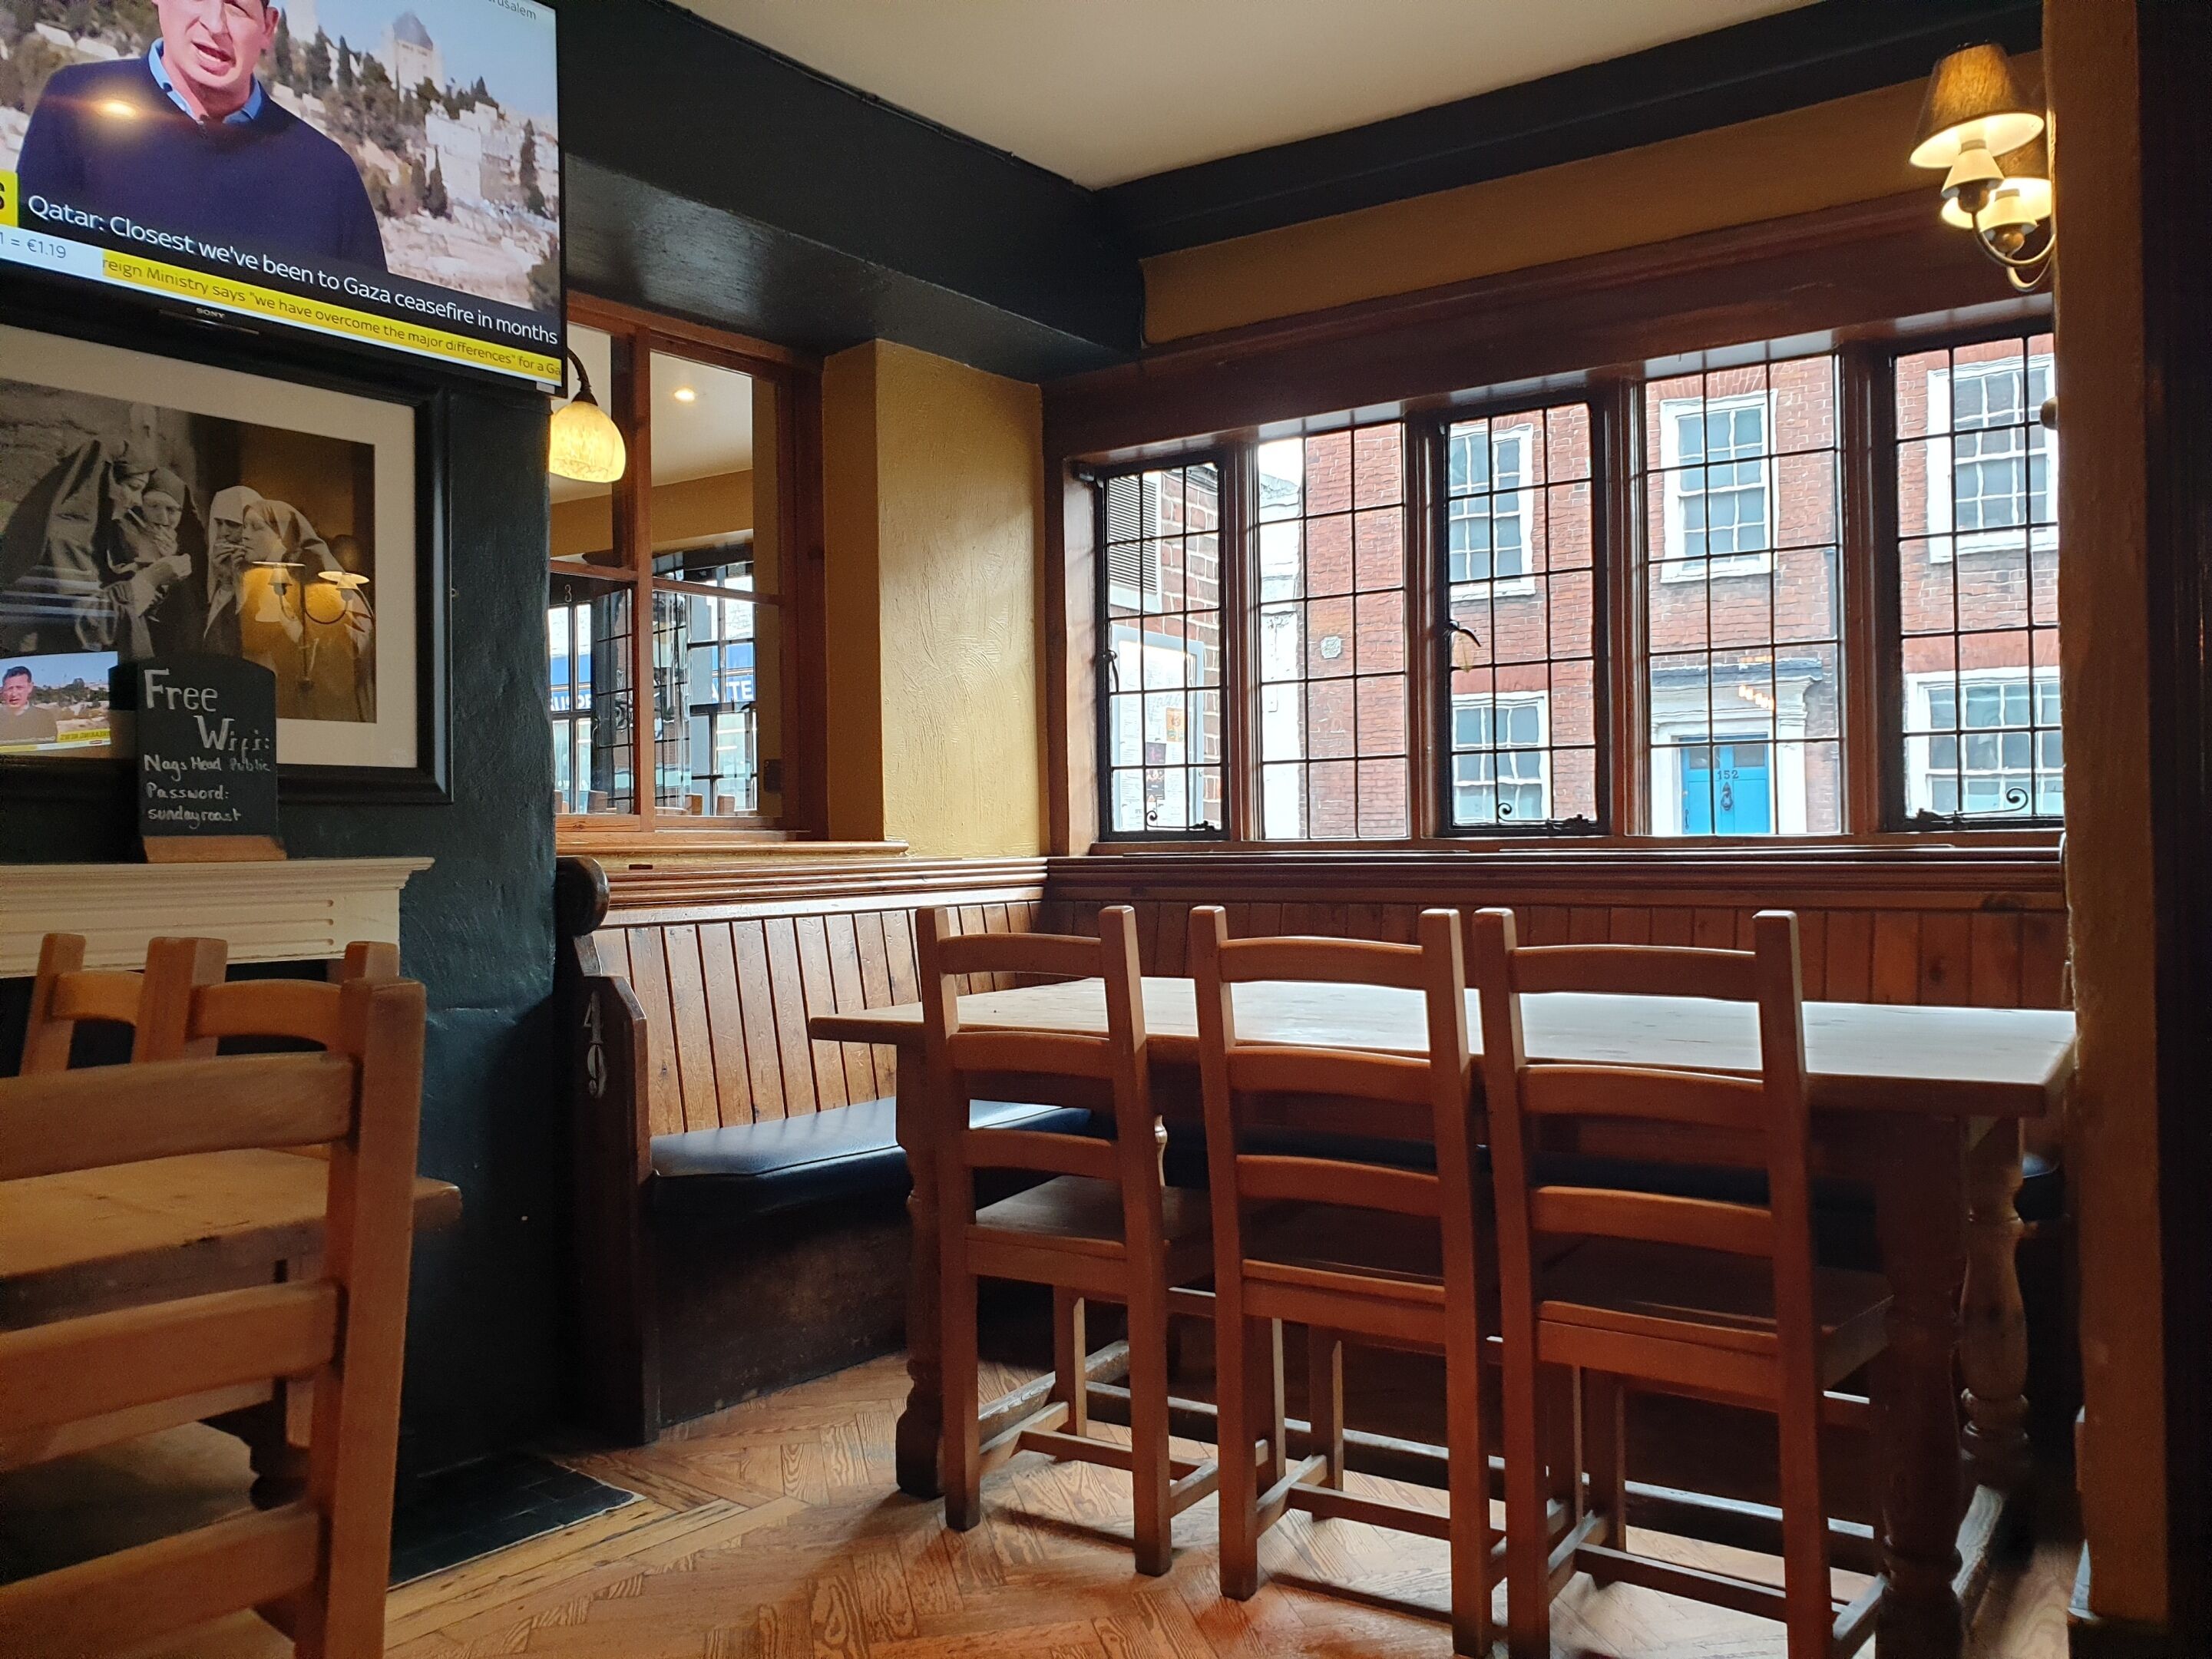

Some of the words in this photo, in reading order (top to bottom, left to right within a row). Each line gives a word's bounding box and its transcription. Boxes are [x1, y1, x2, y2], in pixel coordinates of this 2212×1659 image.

[27, 239, 67, 259] €1.19
[28, 195, 104, 230] Qatar:
[110, 216, 195, 253] Closest
[198, 242, 259, 269] we've
[263, 254, 313, 284] been
[317, 271, 339, 289] to
[343, 277, 391, 304] Gaza
[395, 293, 474, 324] ceasefire
[478, 309, 492, 329] in
[496, 319, 558, 345] months
[102, 259, 142, 279] reign
[147, 266, 209, 294] Ministry
[213, 285, 246, 302] says
[250, 292, 275, 309] "we
[279, 299, 312, 317] have
[316, 310, 379, 333] overcome
[383, 326, 405, 339] the
[408, 334, 442, 349] major
[518, 356, 534, 369] for
[537, 363, 544, 372] a
[196, 307, 225, 319] SONY
[144, 668, 218, 712] Free
[193, 715, 269, 763] Wifi:
[144, 754, 187, 782] Nags
[190, 756, 222, 771] Head
[230, 758, 270, 772] Public
[1717, 769, 1739, 780] 152
[146, 782, 230, 800] Password:
[147, 805, 242, 829] sundayroast
